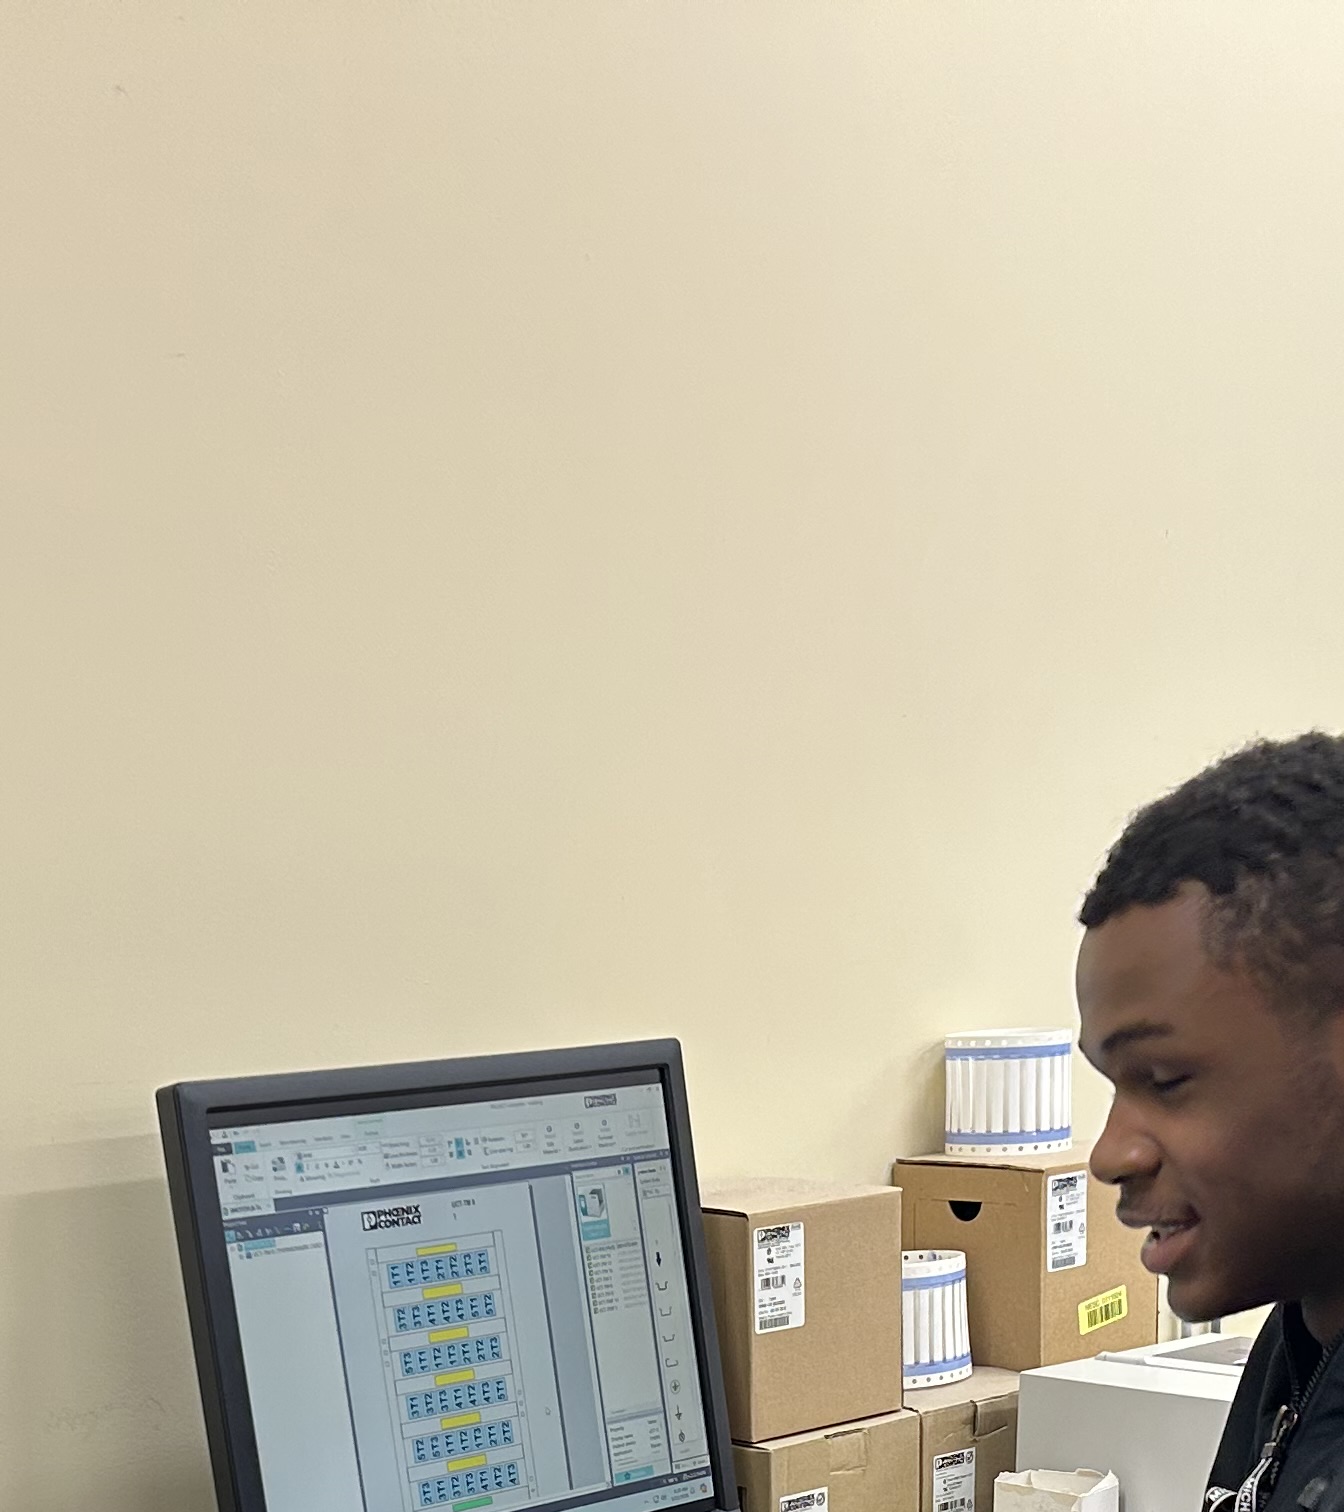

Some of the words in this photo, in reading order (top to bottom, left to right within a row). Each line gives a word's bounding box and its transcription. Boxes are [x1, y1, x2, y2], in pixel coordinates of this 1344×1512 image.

[377, 1215, 422, 1229] CONTACT
[391, 1265, 400, 1285] 1T1
[421, 1260, 430, 1281] 1T3
[436, 1259, 445, 1280] 2T1
[450, 1256, 459, 1277] 2T2
[464, 1253, 474, 1275] 2T3
[478, 1252, 487, 1272] 3T1
[397, 1308, 406, 1329] 3T2
[412, 1306, 421, 1327] 3T3
[427, 1305, 436, 1325] 4T1
[441, 1301, 450, 1322] 4T2
[456, 1299, 465, 1320] 4T3
[471, 1297, 479, 1318] 5T1
[484, 1294, 494, 1315] 5T2
[404, 1352, 413, 1374] 5T3
[418, 1350, 428, 1371] 1T1
[434, 1348, 442, 1368] 1T2
[448, 1345, 456, 1365] 1T3
[462, 1343, 471, 1363] 2T1
[476, 1340, 486, 1360] 2T2
[490, 1337, 499, 1358] 2T3
[410, 1397, 419, 1417] 3T1
[424, 1393, 434, 1414] 3T2
[439, 1390, 448, 1411] 3T3
[454, 1388, 463, 1409] 4T1
[468, 1385, 477, 1406] 4T2
[482, 1382, 491, 1402] 4T3
[497, 1380, 506, 1400] 5T1
[416, 1440, 425, 1460] 5T2
[430, 1437, 440, 1458] 5T3
[445, 1434, 455, 1454] 1T1
[460, 1431, 469, 1451] 1T2
[474, 1428, 483, 1448] 1T3
[488, 1425, 497, 1445] 2T1
[501, 1421, 512, 1443] 2T2
[423, 1483, 432, 1504] 2T3
[437, 1480, 447, 1500] 3T1
[452, 1477, 460, 1497] 3T2
[466, 1473, 474, 1493] 3T3
[480, 1470, 489, 1491] 4T1
[494, 1467, 503, 1488] 4T2
[508, 1464, 517, 1484] 4T3
